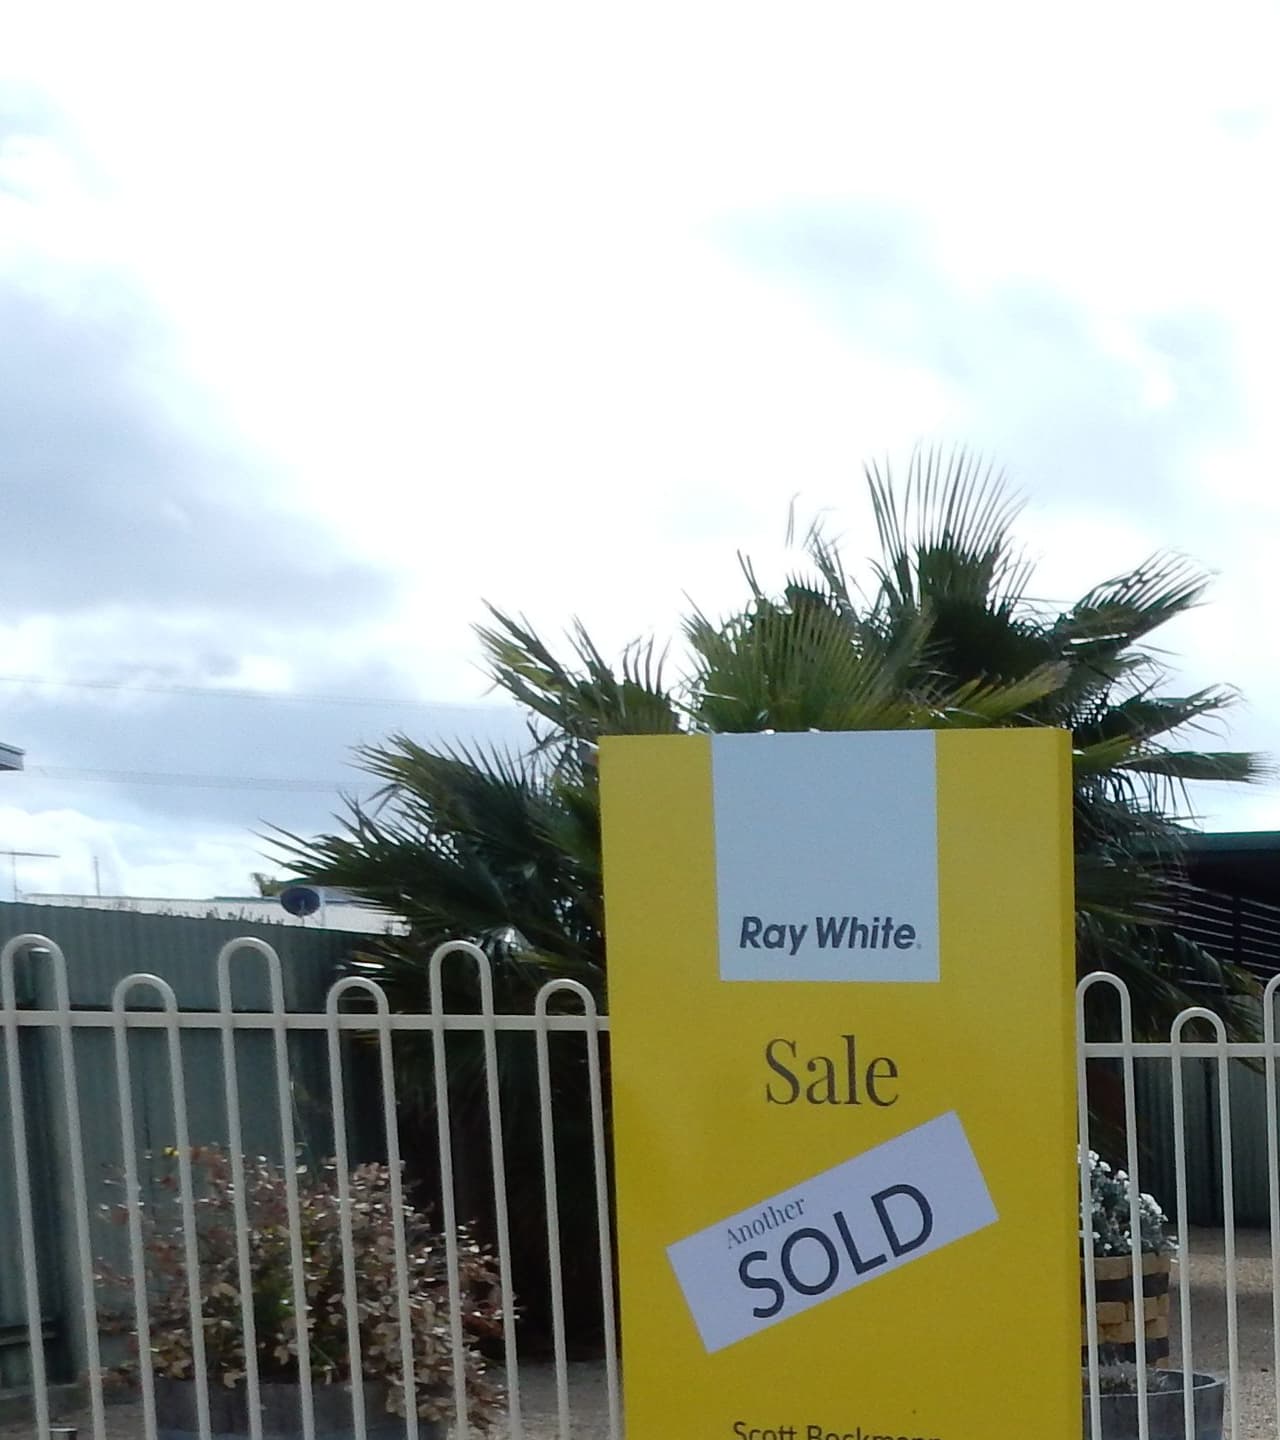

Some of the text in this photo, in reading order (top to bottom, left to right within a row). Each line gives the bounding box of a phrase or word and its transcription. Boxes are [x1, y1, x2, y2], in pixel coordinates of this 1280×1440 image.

[739, 916, 916, 955] Ray White
[765, 1034, 899, 1107] Sale
[727, 1198, 805, 1249] Another
[738, 1183, 934, 1319] SOLD
